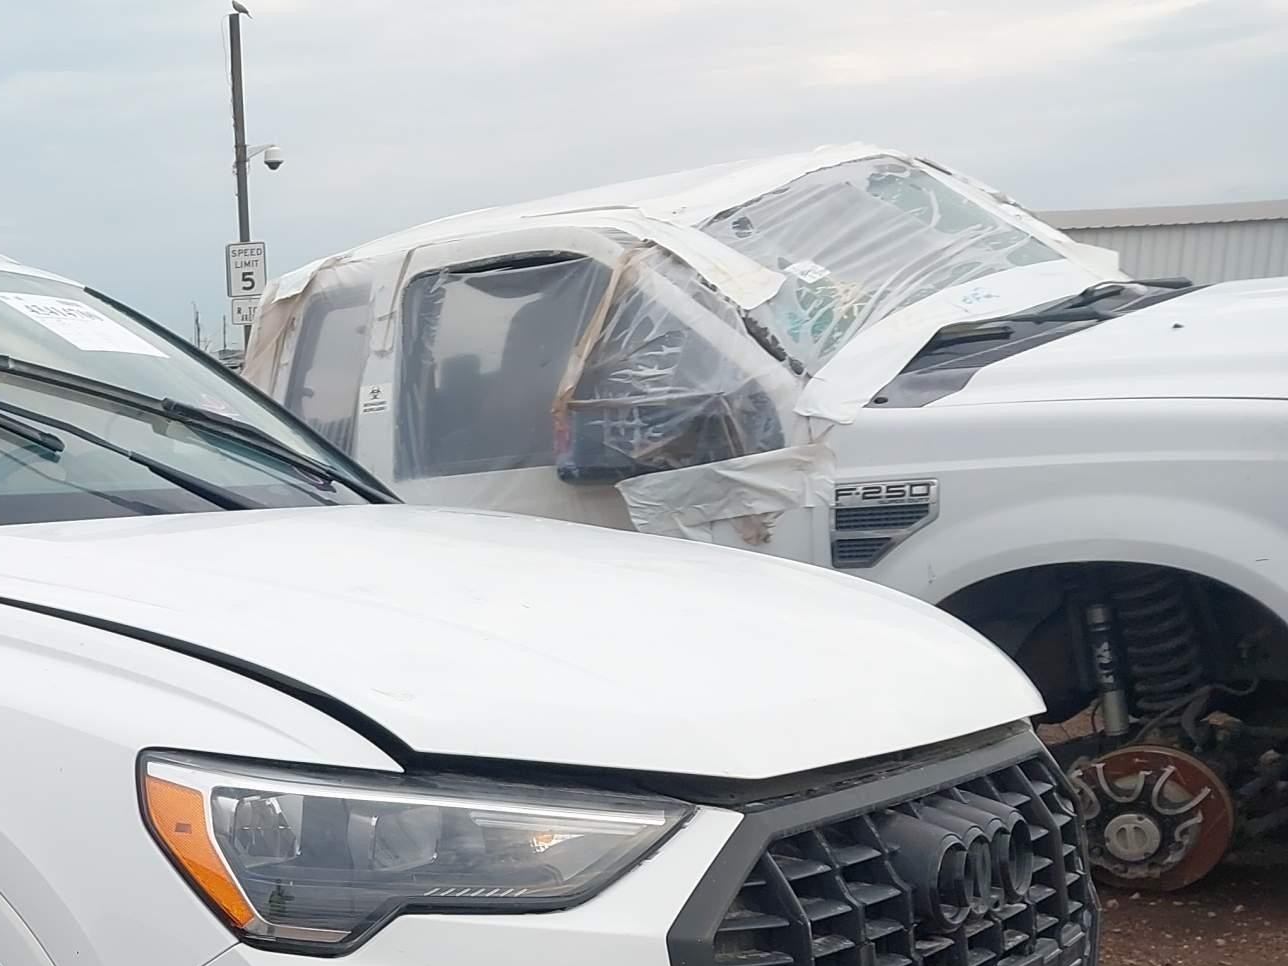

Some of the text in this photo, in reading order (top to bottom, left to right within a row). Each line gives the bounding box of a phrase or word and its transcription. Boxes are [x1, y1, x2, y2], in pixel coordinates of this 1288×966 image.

[231, 248, 263, 258] SPEED
[234, 259, 259, 269] LIMIT
[241, 271, 256, 291] 5
[835, 483, 930, 501] F-250
